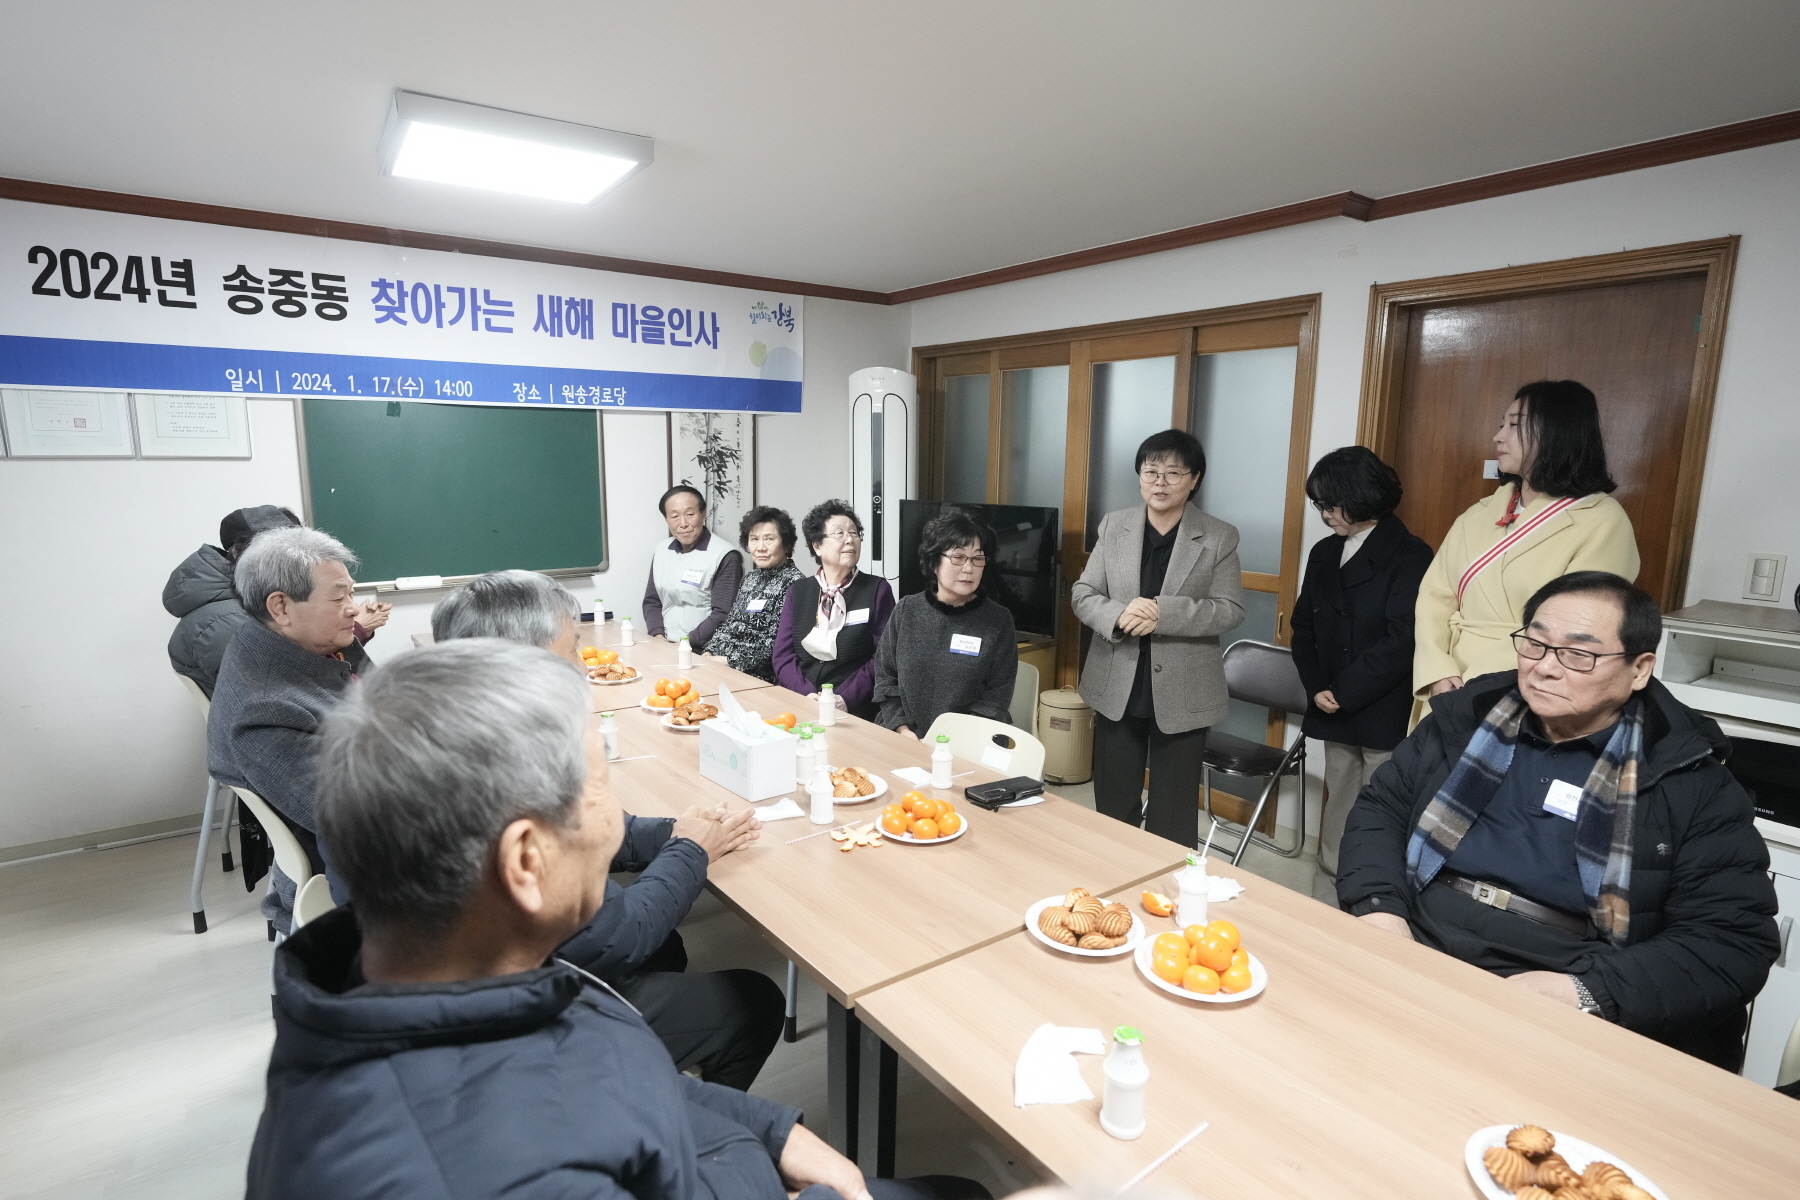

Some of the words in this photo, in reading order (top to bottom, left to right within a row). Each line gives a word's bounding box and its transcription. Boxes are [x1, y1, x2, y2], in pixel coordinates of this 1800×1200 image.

[27, 245, 198, 310] 2024년
[222, 264, 349, 322] 송중동
[370, 278, 516, 334] 찾아가는
[533, 294, 594, 340] 새해
[611, 302, 720, 350] 마을인사
[771, 302, 795, 333] 강북
[225, 368, 264, 393] 일시
[291, 372, 337, 394] 2024.
[347, 374, 362, 395] 1.
[434, 379, 474, 398] 14:00
[512, 382, 542, 402] 장소
[561, 384, 627, 406] 원송경로당
[1753, 806, 1775, 815] MSUNG
